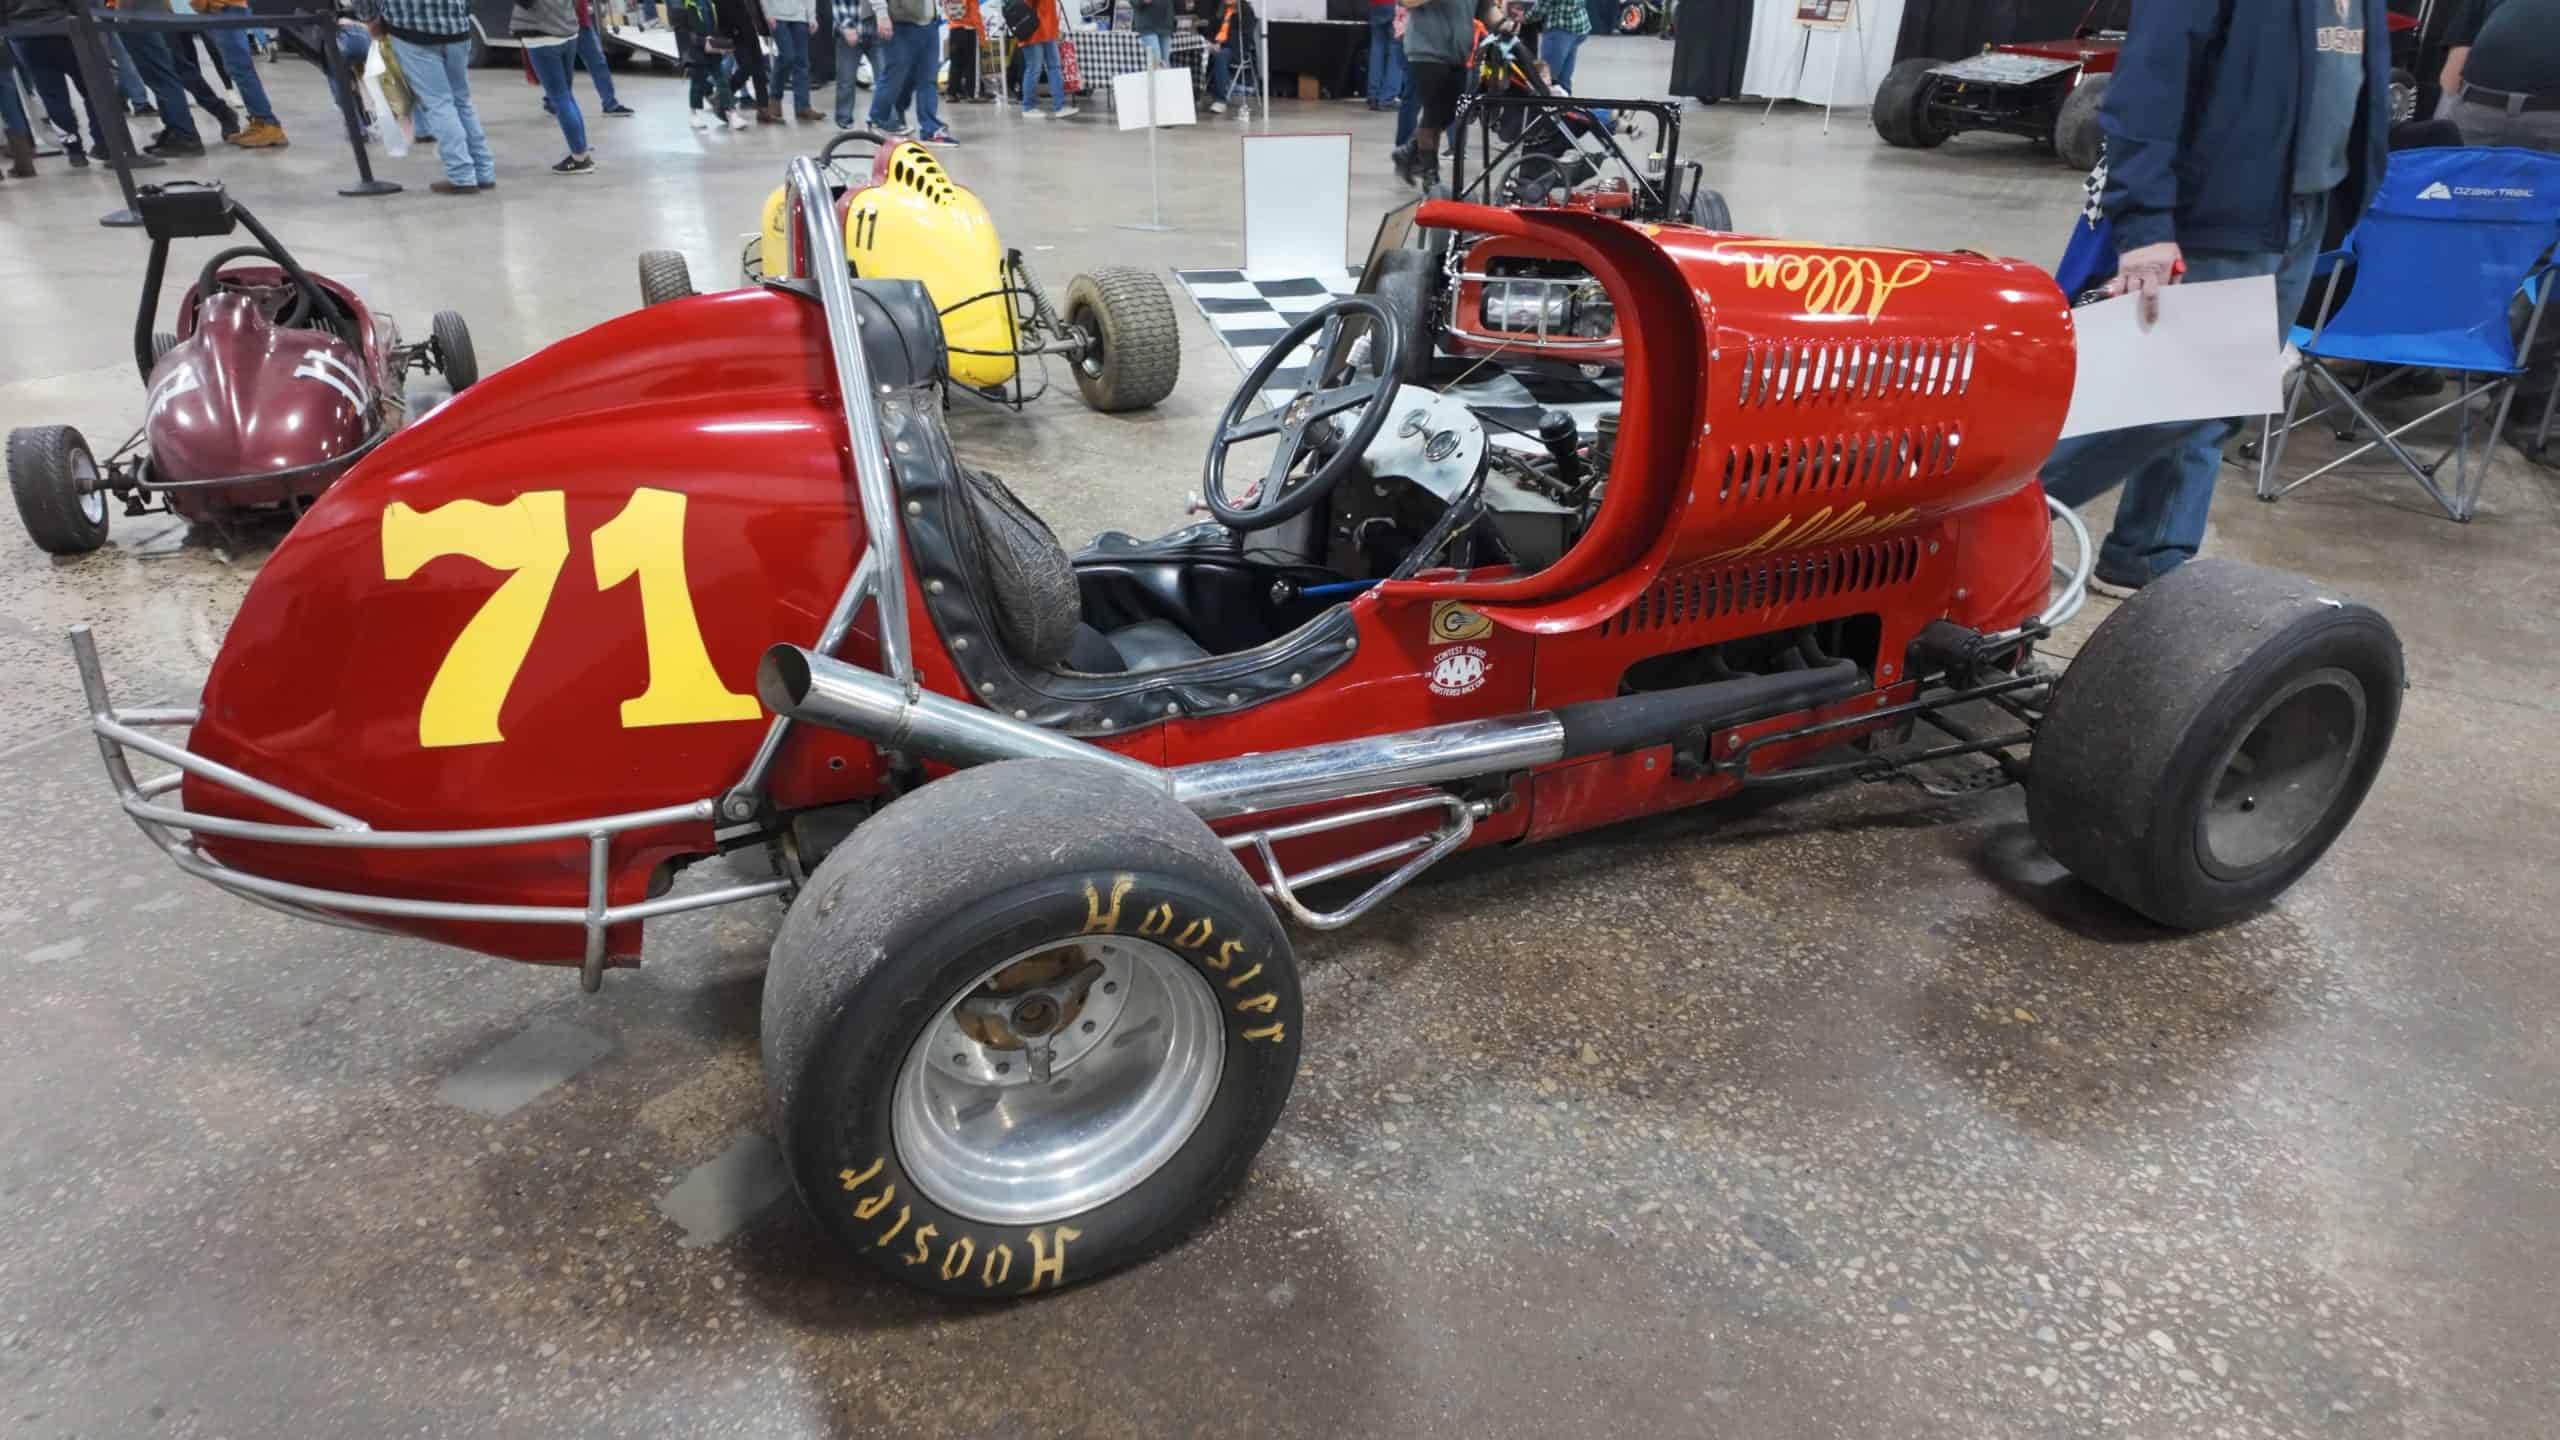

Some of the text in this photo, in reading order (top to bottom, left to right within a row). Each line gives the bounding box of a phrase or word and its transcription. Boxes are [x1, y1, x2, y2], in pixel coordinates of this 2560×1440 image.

[856, 208, 878, 251] 11
[1713, 241, 1931, 325] Allen
[382, 486, 762, 748] 71
[1433, 646, 1487, 664] CONTEST BOARD
[1436, 655, 1483, 687] AAA
